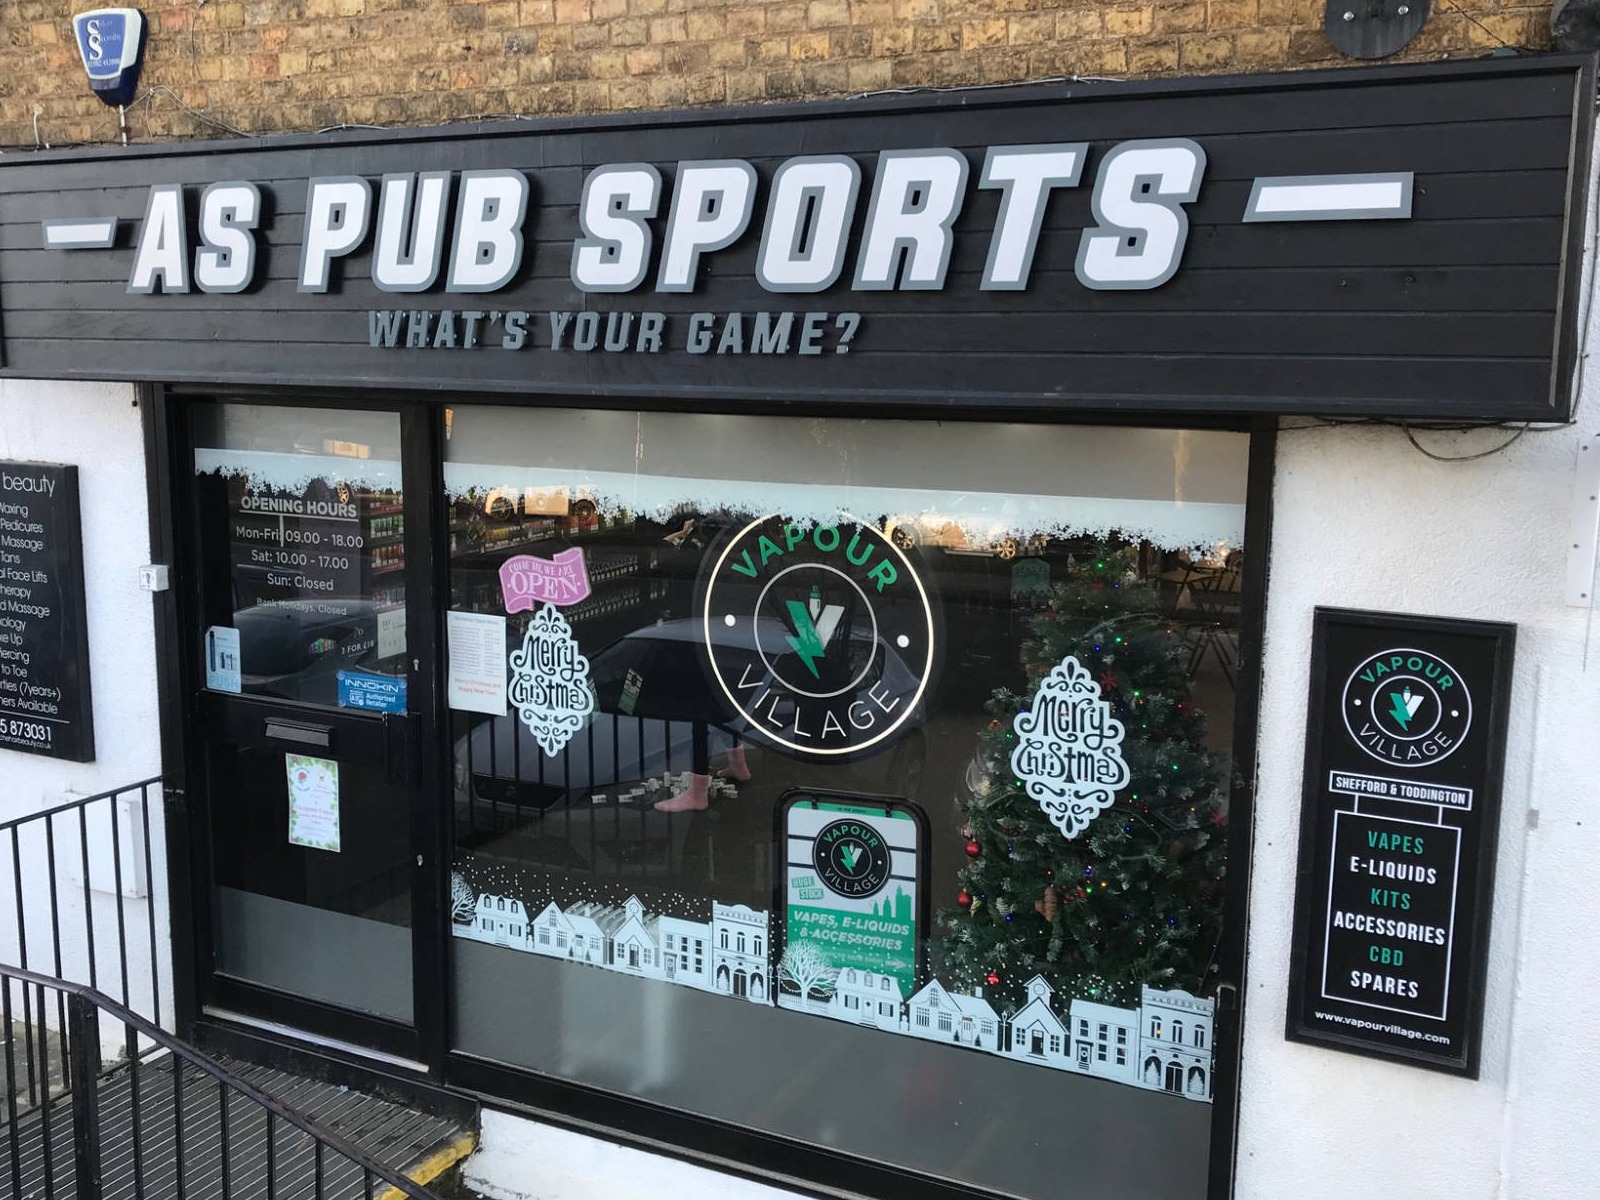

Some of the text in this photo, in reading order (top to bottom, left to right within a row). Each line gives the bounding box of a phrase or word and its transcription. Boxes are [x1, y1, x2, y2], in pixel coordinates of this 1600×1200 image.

[127, 138, 1207, 294] AS PUB SPORTS
[367, 310, 862, 355] WHAT'S YOUR GAME?
[2, 471, 55, 497] beauty
[241, 496, 357, 518] OPENING HOURS
[0, 518, 43, 534] Pedicures
[1, 535, 43, 552] Massage
[285, 530, 320, 545] 09.00
[331, 534, 364, 549] 18.00
[251, 550, 273, 563] Sat:
[276, 552, 307, 566] 10.00
[318, 556, 349, 570] 17.00
[731, 523, 898, 593] VAPOUR
[7, 567, 30, 582] Face
[31, 570, 48, 584] Lifts
[267, 573, 334, 591] Sun: Closed
[510, 571, 579, 599] OPEN
[8, 600, 50, 618] Massage
[318, 604, 347, 616] Closed
[10, 633, 23, 646] Up
[513, 635, 585, 681] Merry
[12, 664, 27, 678] Toe
[1359, 656, 1454, 692] VAPOUR
[345, 679, 399, 693] INNOKIN
[17, 698, 58, 715] Available
[738, 663, 900, 739] VILLAGE
[10, 720, 52, 742] 873031
[1019, 694, 1119, 750] Merry
[1359, 723, 1453, 761] VILLAGE
[1335, 776, 1466, 804] SHEFFORD & TODDINGTON
[823, 825, 879, 848] VAPOUR
[1367, 830, 1425, 855] VAPES
[824, 868, 880, 893] VILLAGE
[1350, 856, 1437, 885] E-LIQUIDS
[1370, 887, 1411, 910] KITS
[794, 911, 910, 936] VAPES, E-LIQUIDS
[1334, 911, 1445, 945] ACCESSORIES
[811, 928, 902, 950] ACCESSORIES
[1369, 945, 1404, 967] CBD
[1350, 970, 1419, 998] SPARES
[1315, 1011, 1450, 1045] www.vapourvillage.com
